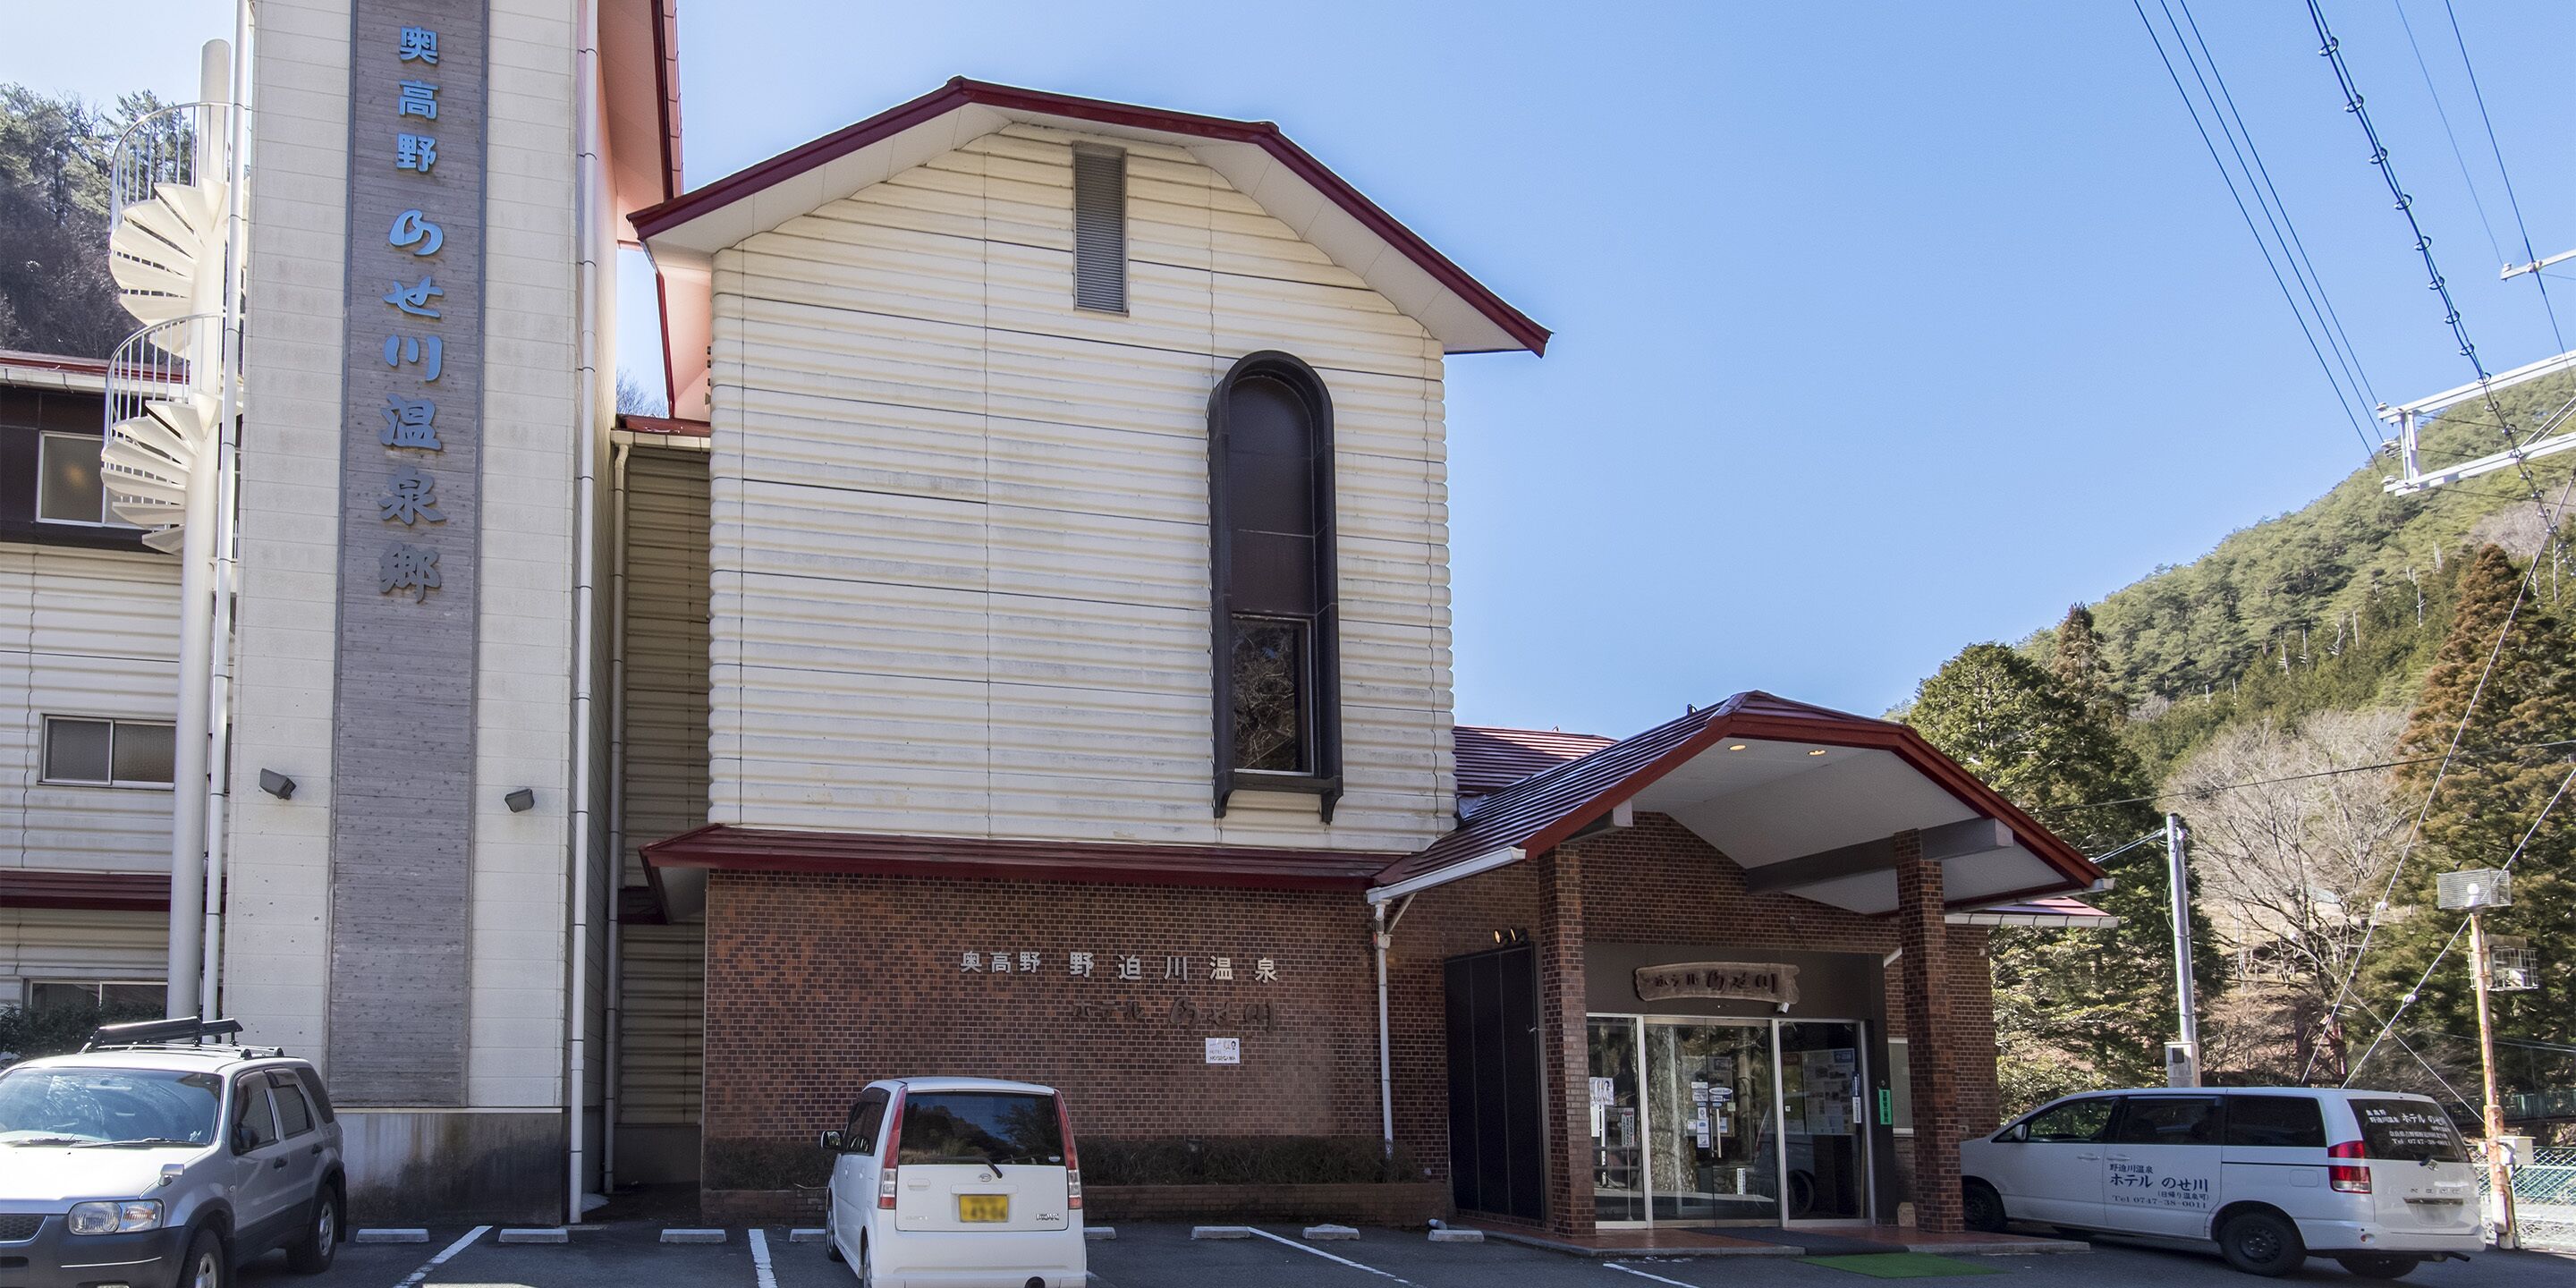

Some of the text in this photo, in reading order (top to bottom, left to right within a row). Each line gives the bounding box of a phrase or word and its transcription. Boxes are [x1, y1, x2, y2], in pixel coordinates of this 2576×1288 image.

[378, 25, 446, 605] 奥高野 のせ川温泉郷
[960, 950, 1279, 984] 奥高野 野迫川温泉
[1073, 999, 1145, 1021] ホテル
[2400, 1113, 2426, 1124] ホテル
[2109, 1164, 2154, 1174] 野迫川温泉
[2110, 1173, 2208, 1192] ホテル のせ川
[2112, 1195, 2207, 1209] Tel 0747-38-0011
